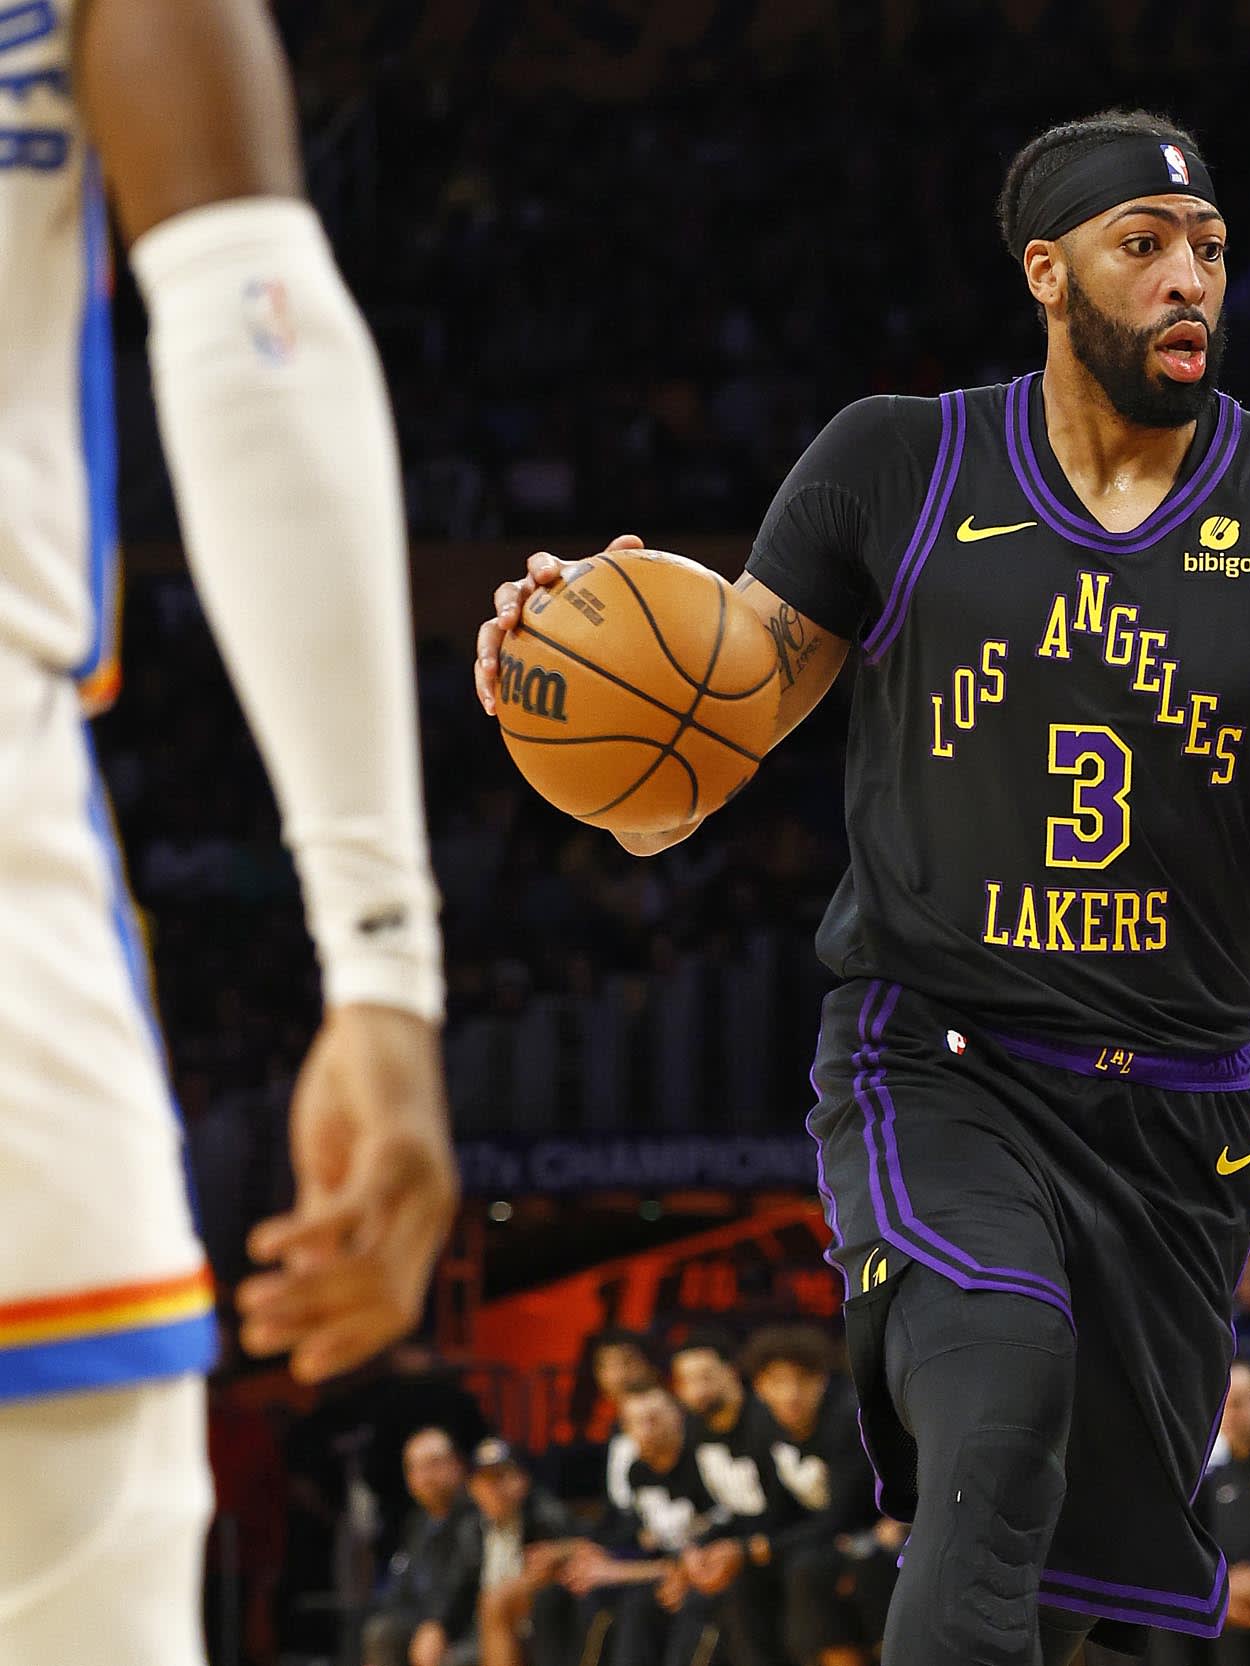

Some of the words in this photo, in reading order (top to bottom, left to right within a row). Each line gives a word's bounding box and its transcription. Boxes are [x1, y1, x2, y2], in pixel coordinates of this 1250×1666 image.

[930, 638, 1008, 759] LOS
[1037, 571, 1245, 786] ANGELES
[1045, 722, 1133, 870] 3
[981, 881, 1169, 953] LAKERS
[1094, 1046, 1135, 1075] LAL
